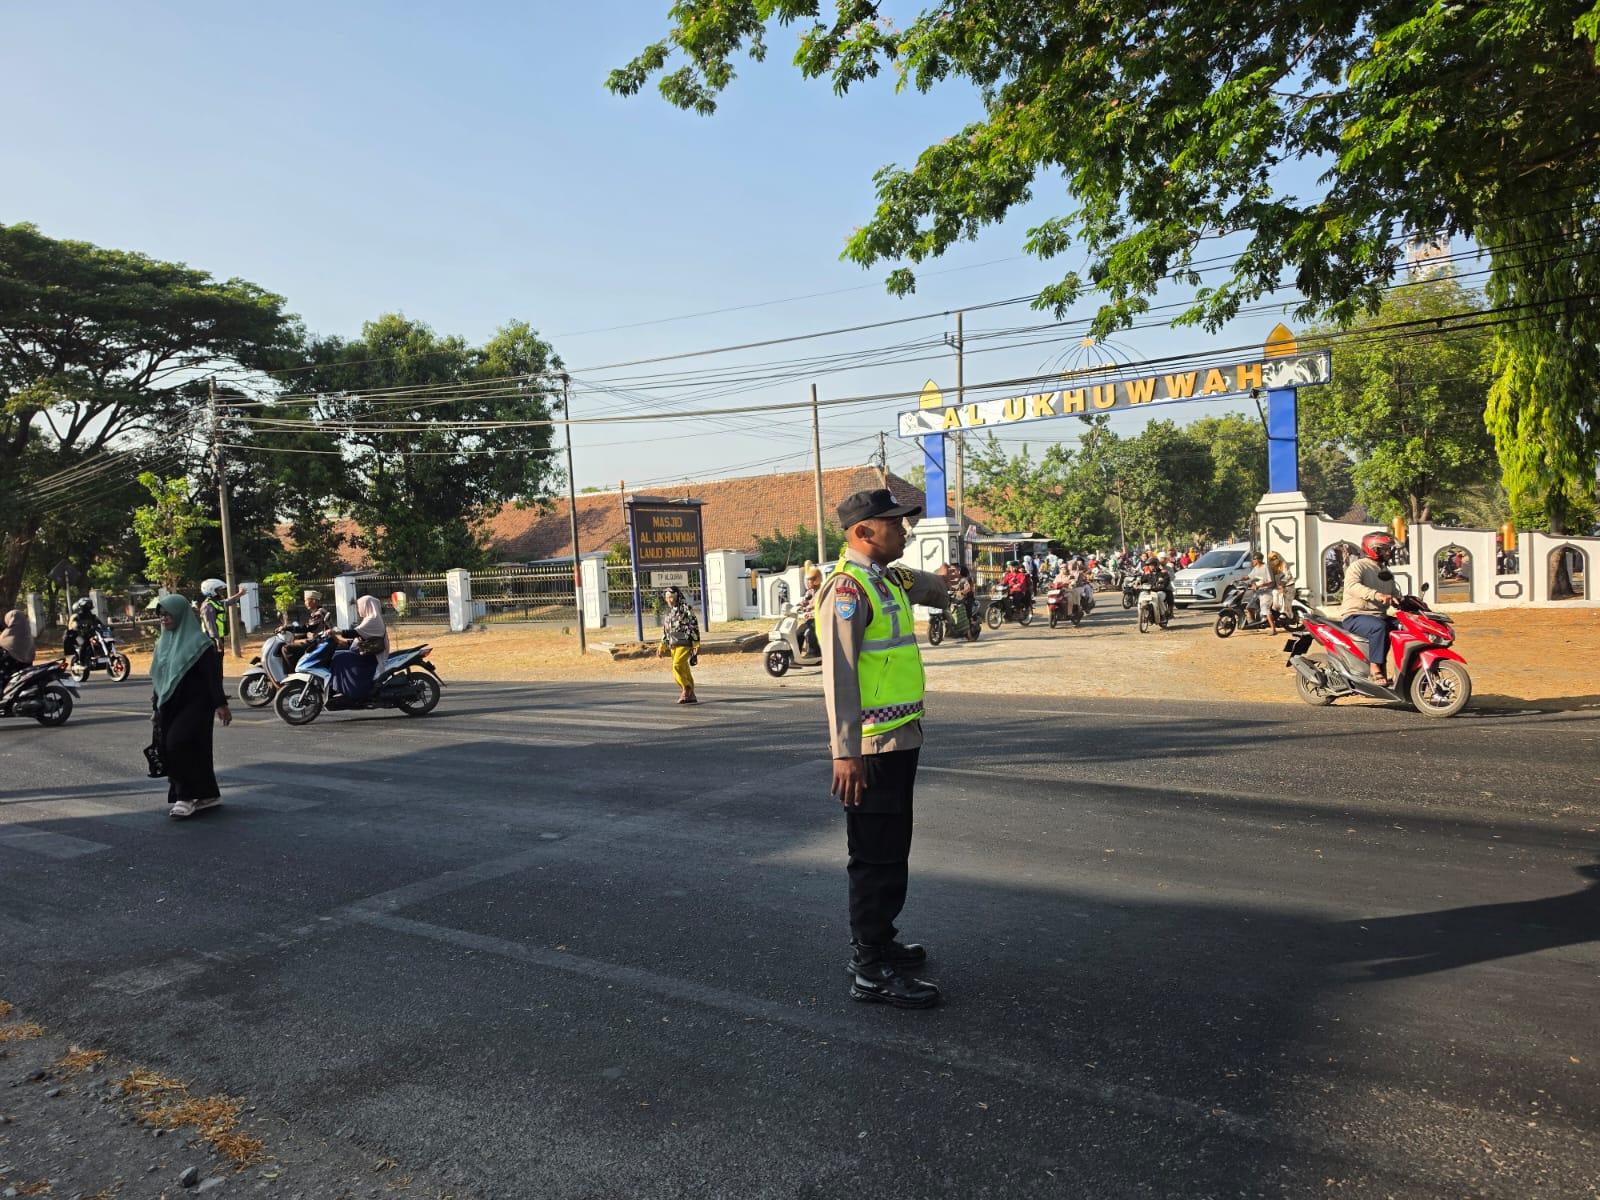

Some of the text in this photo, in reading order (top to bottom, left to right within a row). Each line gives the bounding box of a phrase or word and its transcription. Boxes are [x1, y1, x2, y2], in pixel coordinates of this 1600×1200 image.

[943, 404, 986, 430] AL
[1004, 363, 1264, 421] UKHUWWAH
[652, 516, 683, 528] MASJID
[640, 531, 696, 543] AL UKHUWWAH
